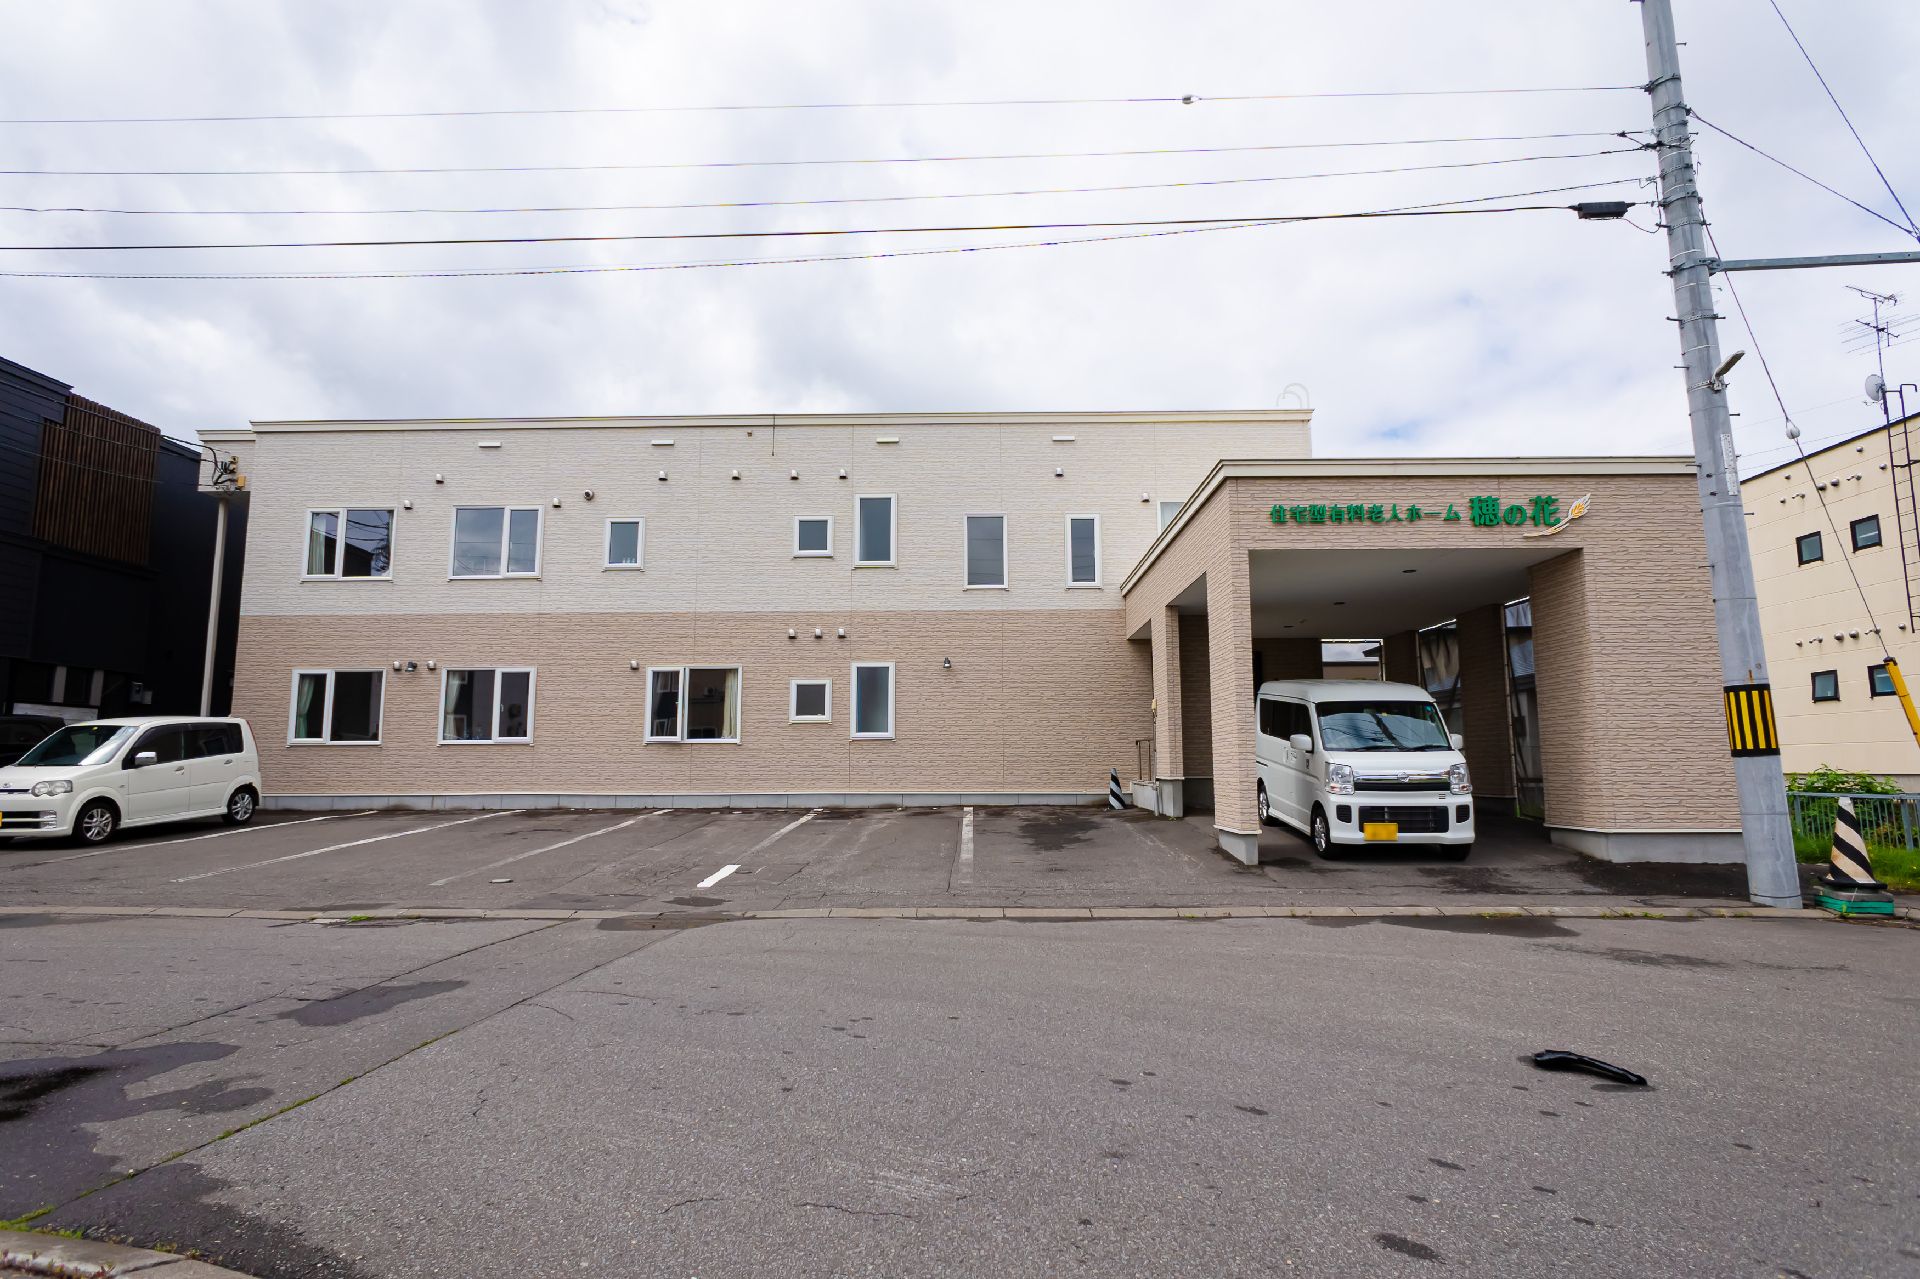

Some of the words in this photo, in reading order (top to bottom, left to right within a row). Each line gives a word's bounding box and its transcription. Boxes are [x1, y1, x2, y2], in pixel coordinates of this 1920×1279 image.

[1270, 503, 1462, 524] 住宅型有料老人ホーム
[1470, 495, 1562, 527] 穂の花
